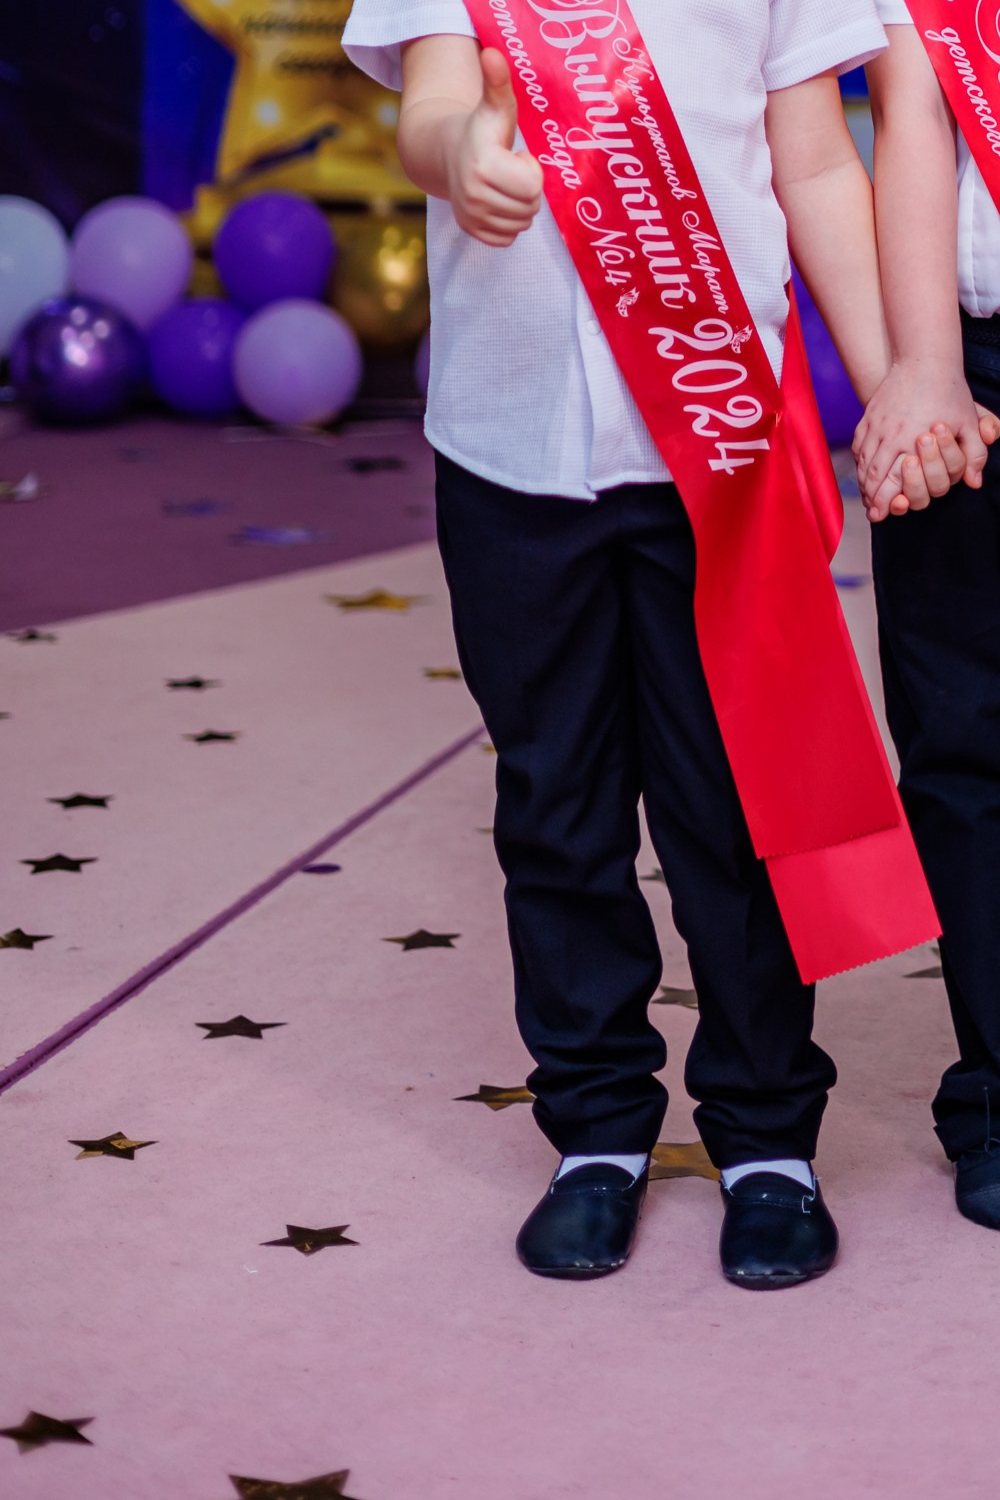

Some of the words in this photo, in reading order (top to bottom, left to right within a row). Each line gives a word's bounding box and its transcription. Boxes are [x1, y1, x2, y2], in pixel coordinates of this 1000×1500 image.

[537, 118, 582, 190] сада
[575, 196, 636, 287] №4
[612, 37, 698, 201] Кульджанов
[681, 210, 730, 315] Марат
[647, 318, 771, 476] 2024
